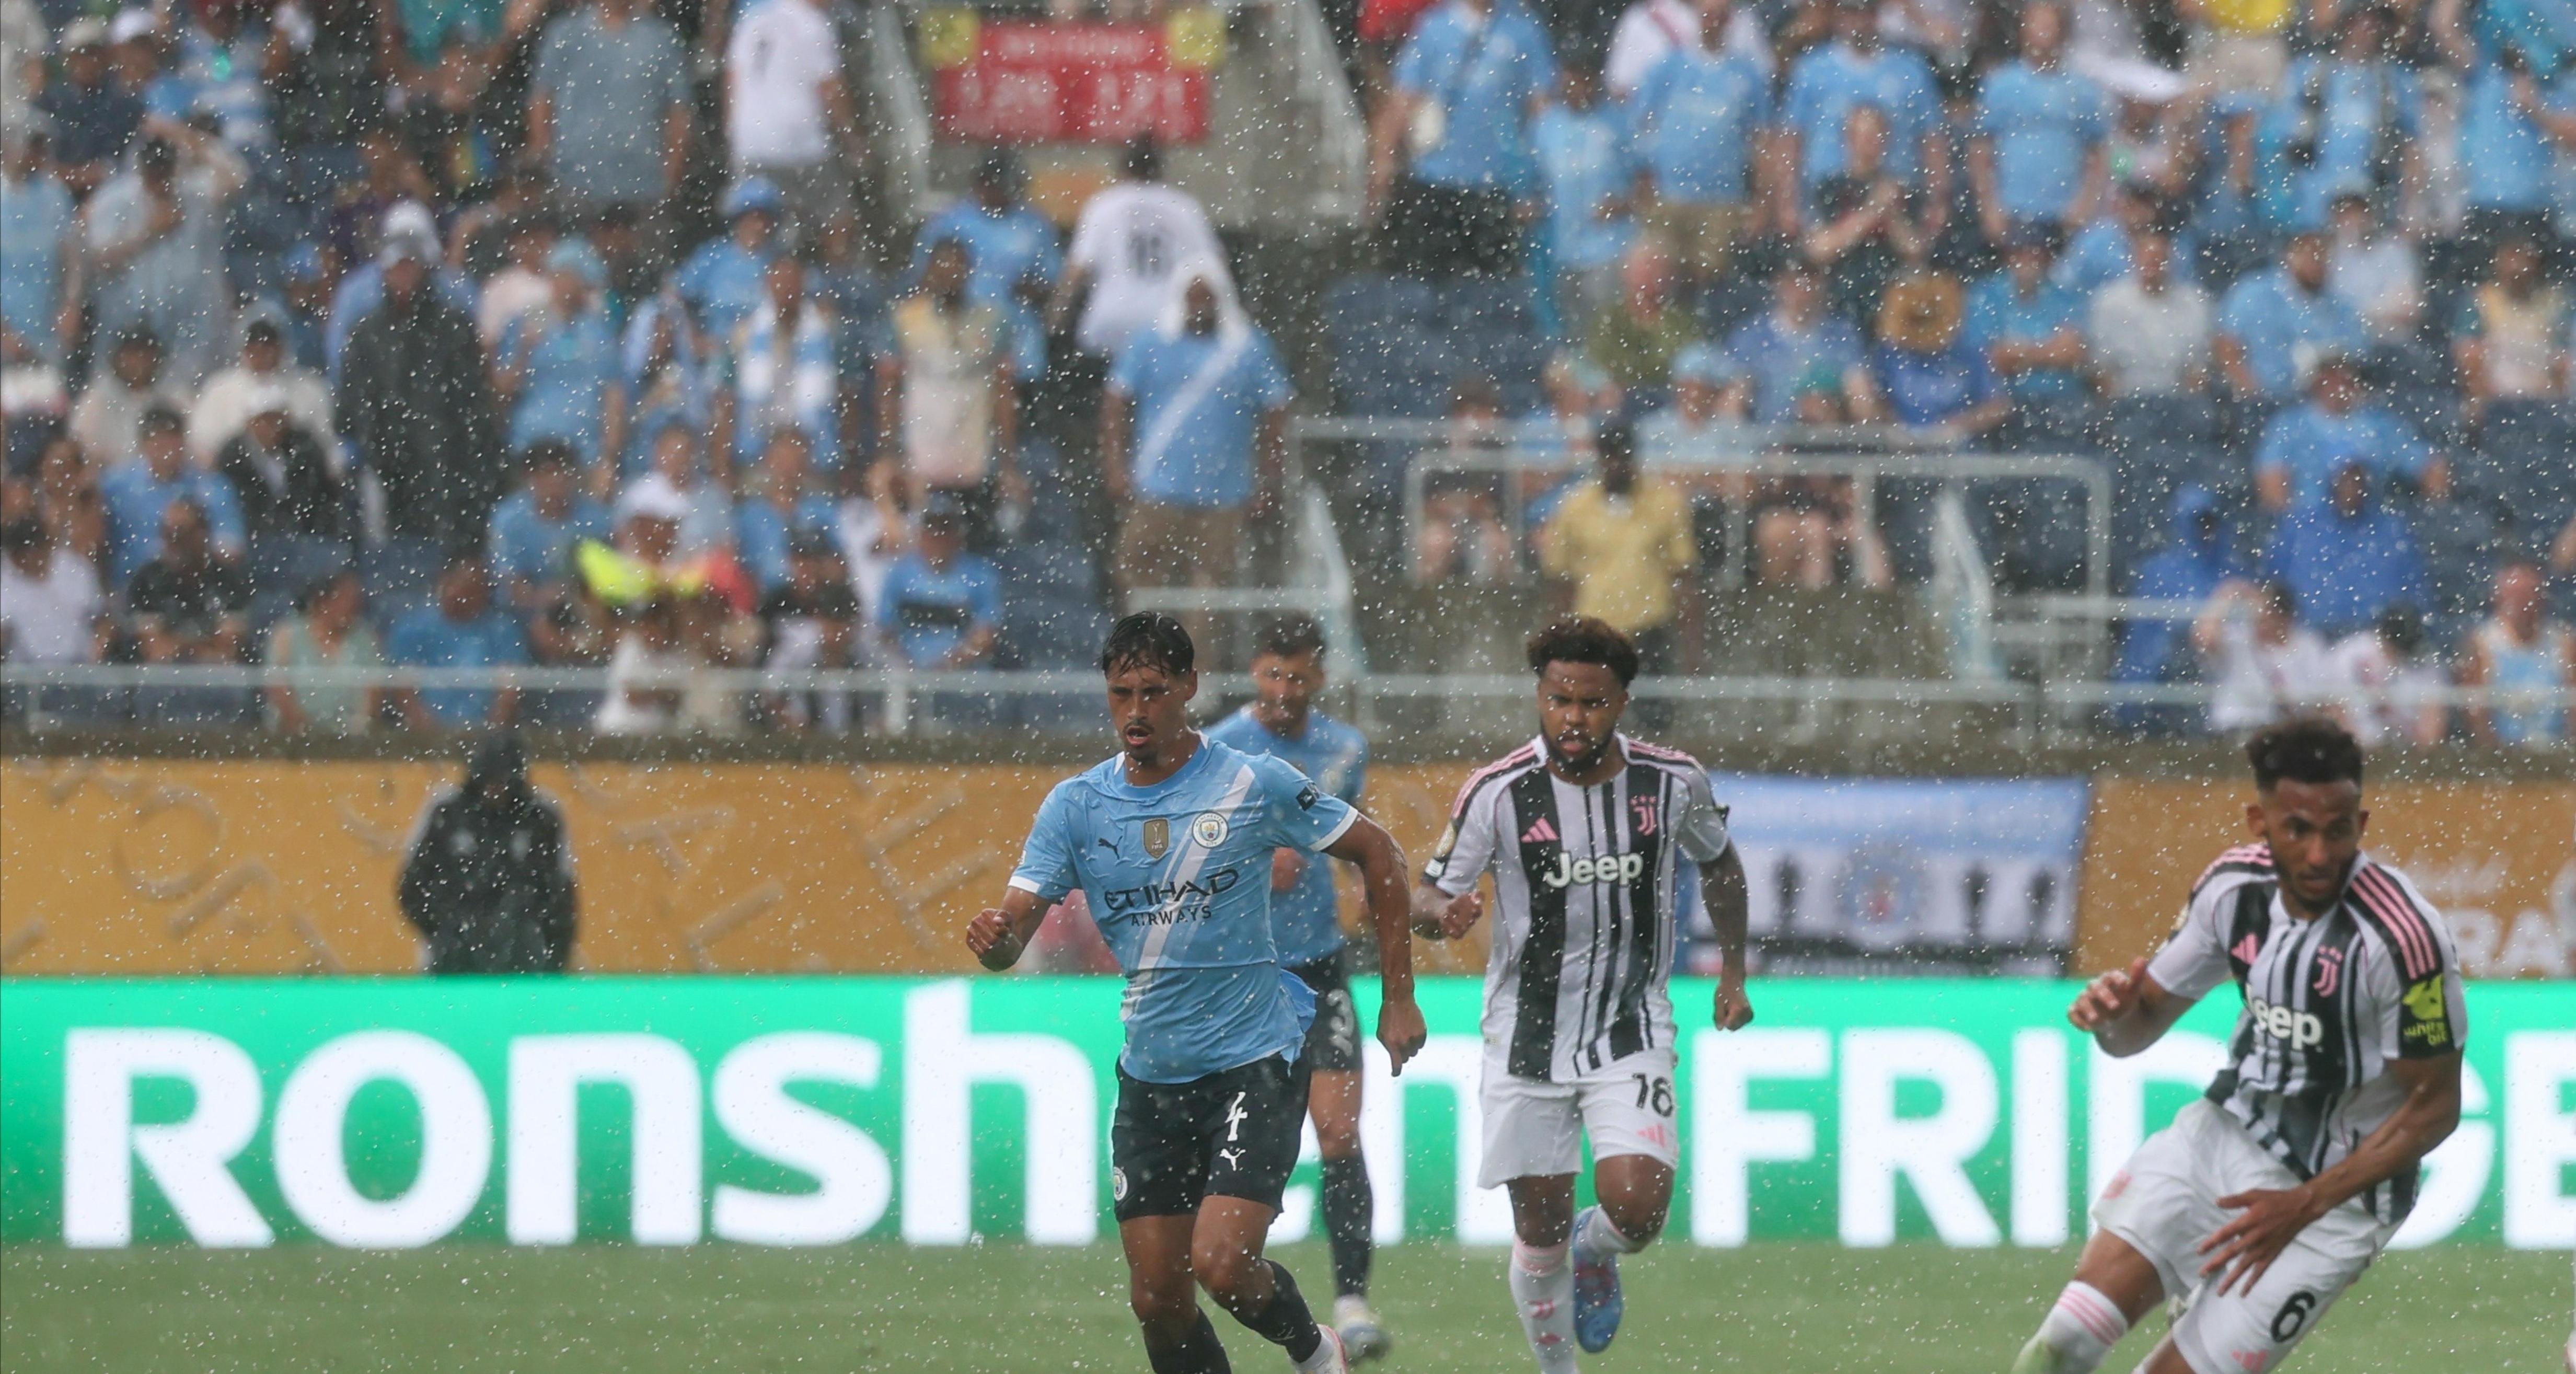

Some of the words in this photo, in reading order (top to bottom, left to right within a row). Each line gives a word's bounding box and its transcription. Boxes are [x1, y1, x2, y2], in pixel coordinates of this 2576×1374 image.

[1104, 868, 1239, 911] ETIHAD
[1543, 852, 1644, 888] Jeep
[1130, 905, 1212, 927] AIRWAYS
[1224, 1091, 1249, 1142] 4
[1631, 1073, 1673, 1118] 16
[2271, 1290, 2316, 1344] 6
